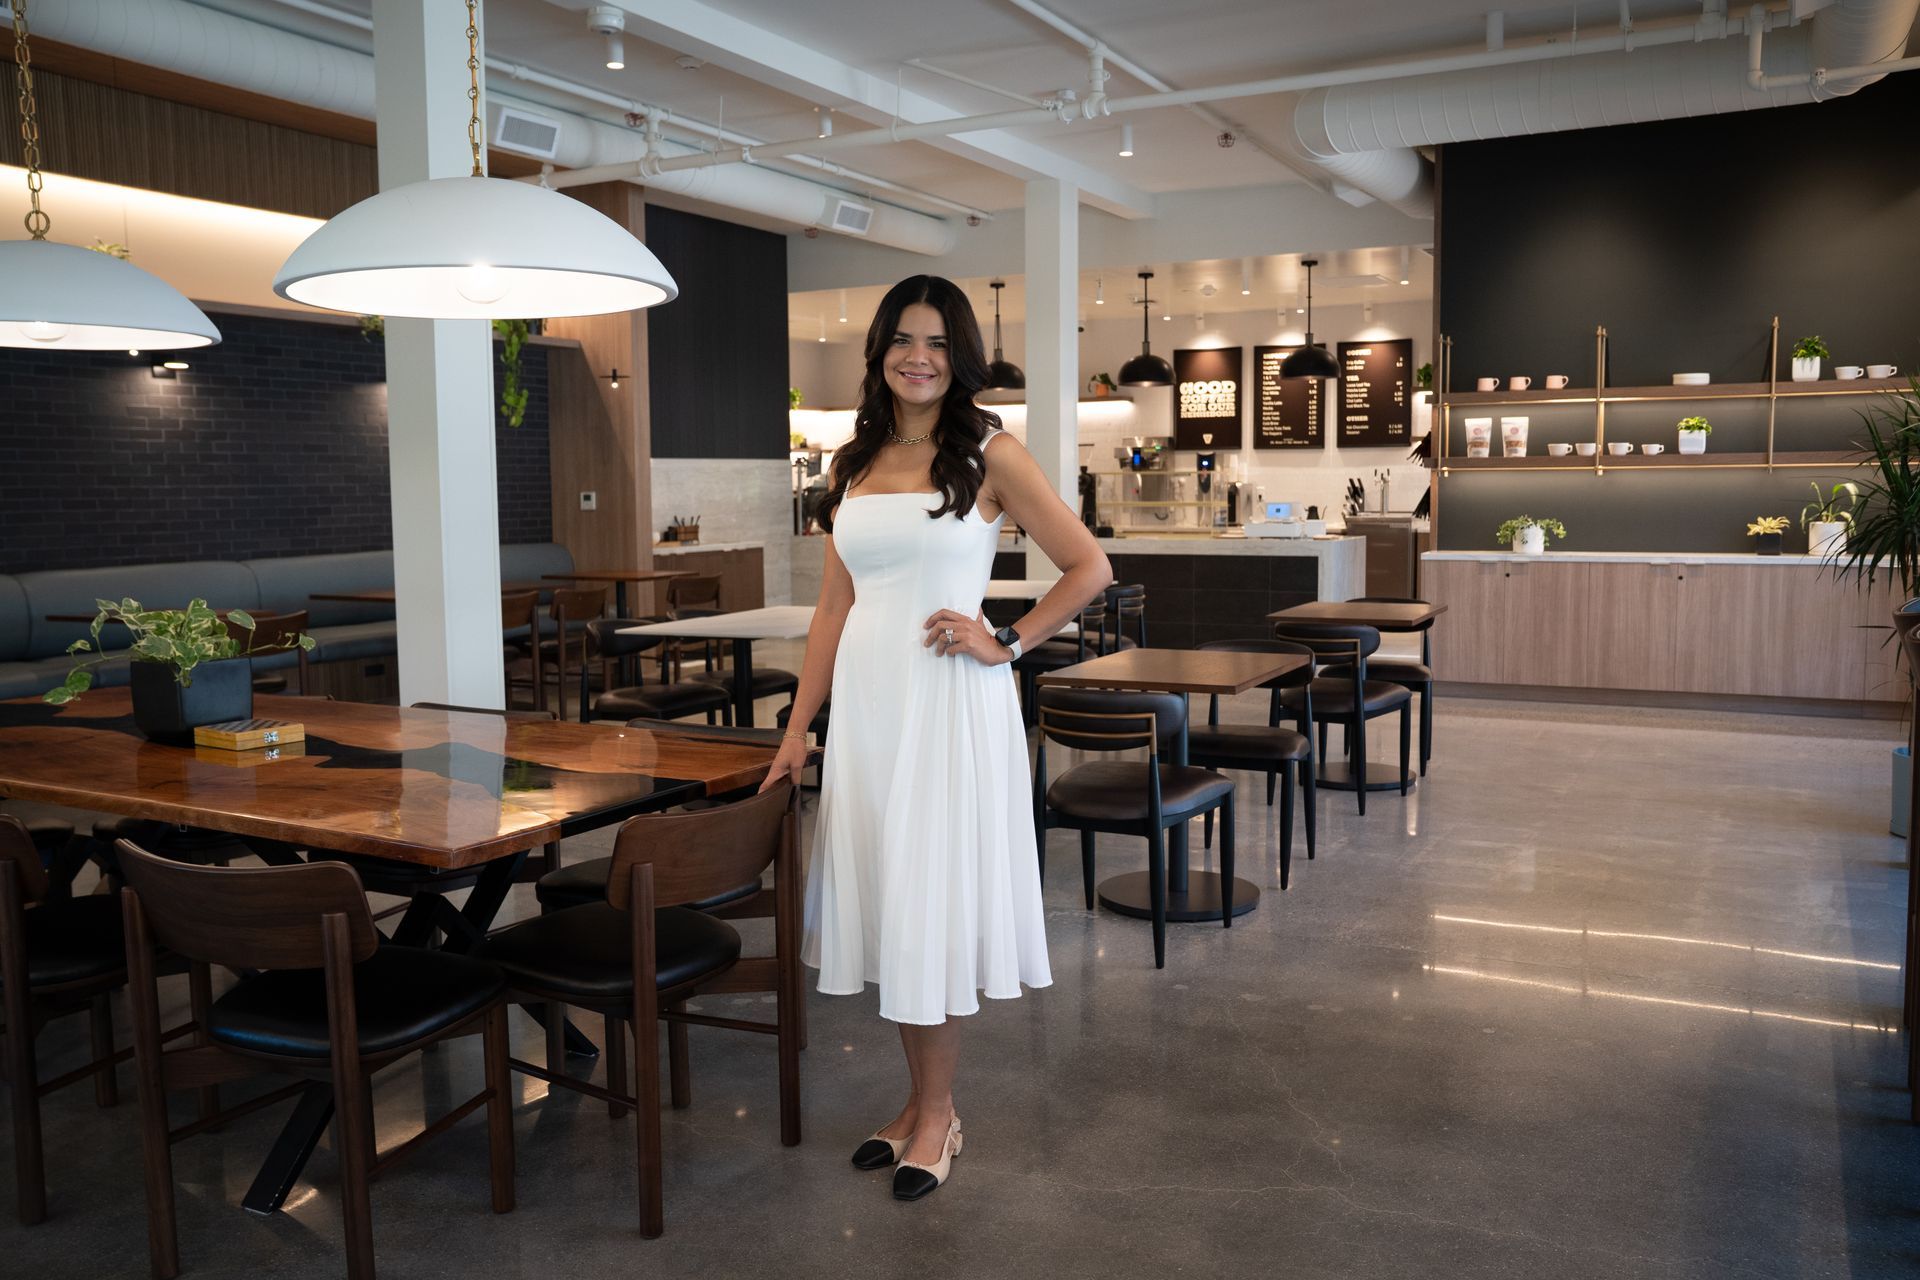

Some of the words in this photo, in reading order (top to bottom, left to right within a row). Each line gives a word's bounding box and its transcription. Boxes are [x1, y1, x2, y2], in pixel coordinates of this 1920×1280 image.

[1180, 380, 1236, 395] GOOD
[1180, 393, 1235, 404] COFFEE
[1180, 403, 1206, 412] FOR
[1207, 403, 1235, 411] OUR
